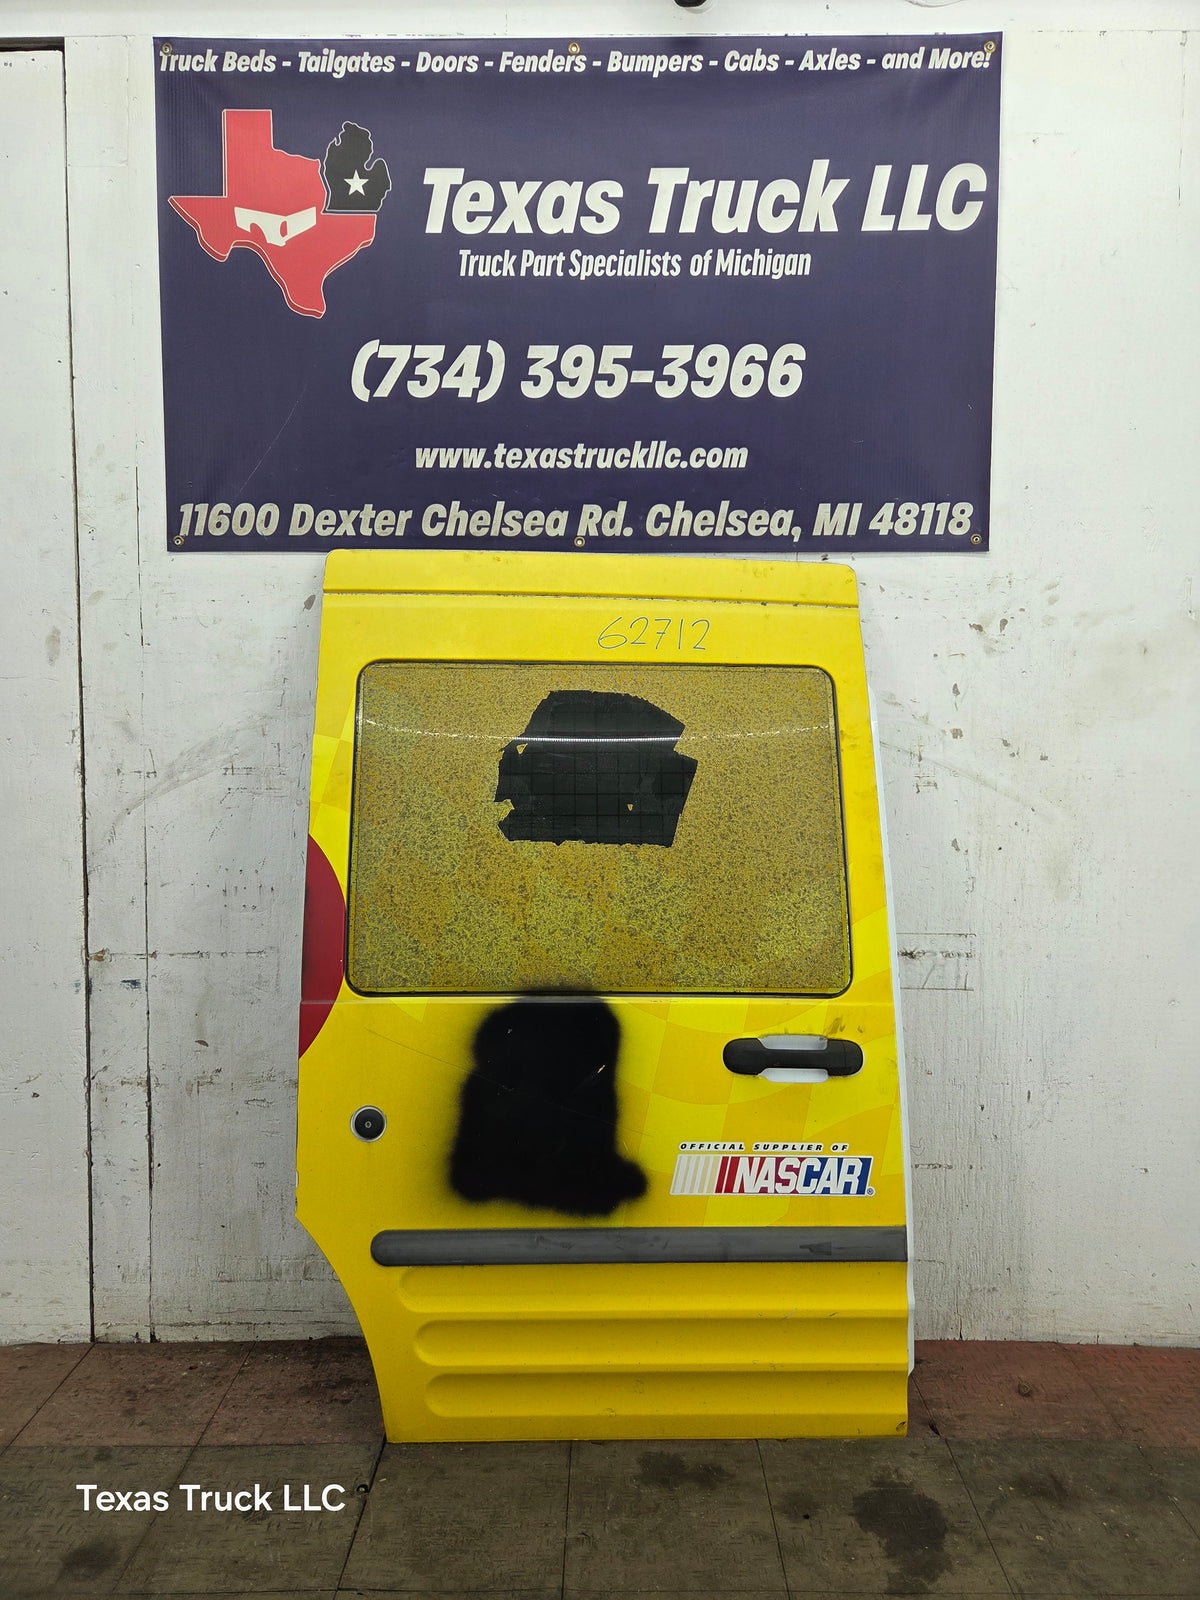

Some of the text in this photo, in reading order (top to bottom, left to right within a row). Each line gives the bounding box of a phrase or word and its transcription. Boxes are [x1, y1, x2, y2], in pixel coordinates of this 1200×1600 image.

[159, 49, 218, 72] Truck
[223, 50, 276, 72] Beds
[298, 48, 395, 78] Tailgates
[416, 51, 479, 72] Doors
[500, 49, 586, 73] Fenders
[607, 51, 703, 77] Bumpers
[724, 48, 780, 72] Cabs
[799, 49, 861, 71] Axles
[882, 47, 925, 70] and
[928, 48, 992, 69] More!
[423, 159, 988, 235] Texas Truck LLC
[459, 249, 812, 280] Truck Part Specialists of Michigan
[351, 339, 806, 403] (734) 395-3966
[415, 441, 749, 469] www.texastruckllc.com
[179, 501, 974, 542] 11600 Dexter Chelsea Rd. Chelsea, MI 48118
[597, 616, 711, 650] 62712
[753, 1143, 823, 1151] SUPPLIER
[733, 1157, 863, 1194] NASCAR
